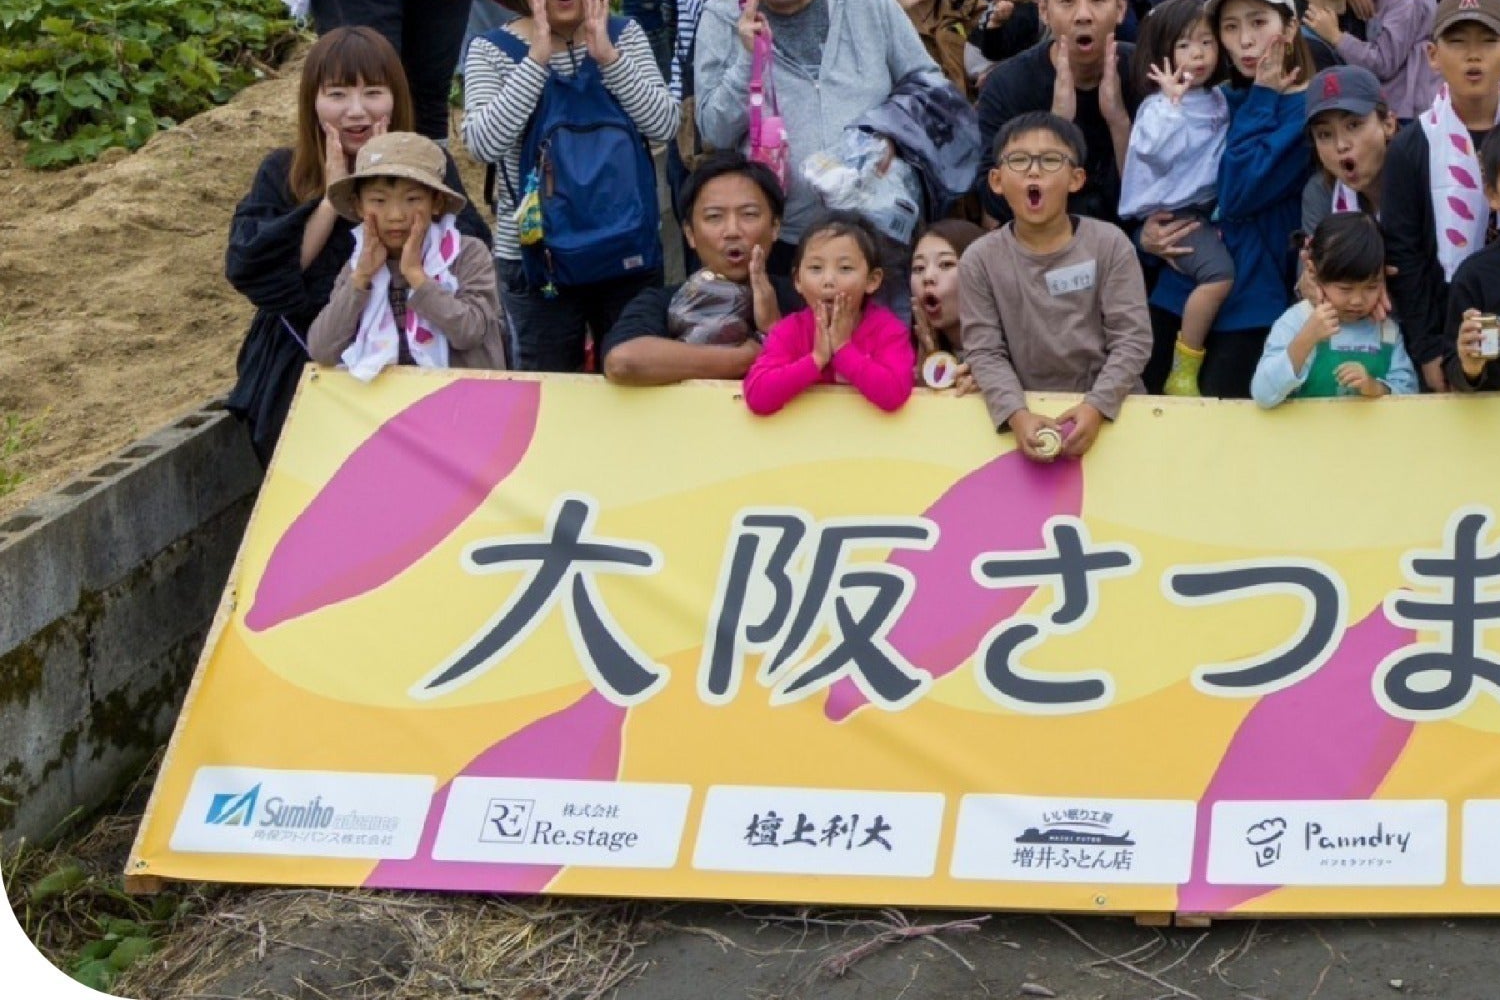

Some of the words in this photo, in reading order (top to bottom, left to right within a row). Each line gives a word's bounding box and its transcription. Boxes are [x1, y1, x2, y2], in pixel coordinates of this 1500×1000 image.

[1323, 73, 1341, 99] A
[259, 795, 335, 829] Sumiho
[561, 802, 620, 819] 株式会社
[530, 820, 639, 851] Re.stage
[743, 810, 892, 851] 檀上利大
[1304, 821, 1411, 853] Panndry
[1011, 846, 1134, 871] 増井ふとん店
